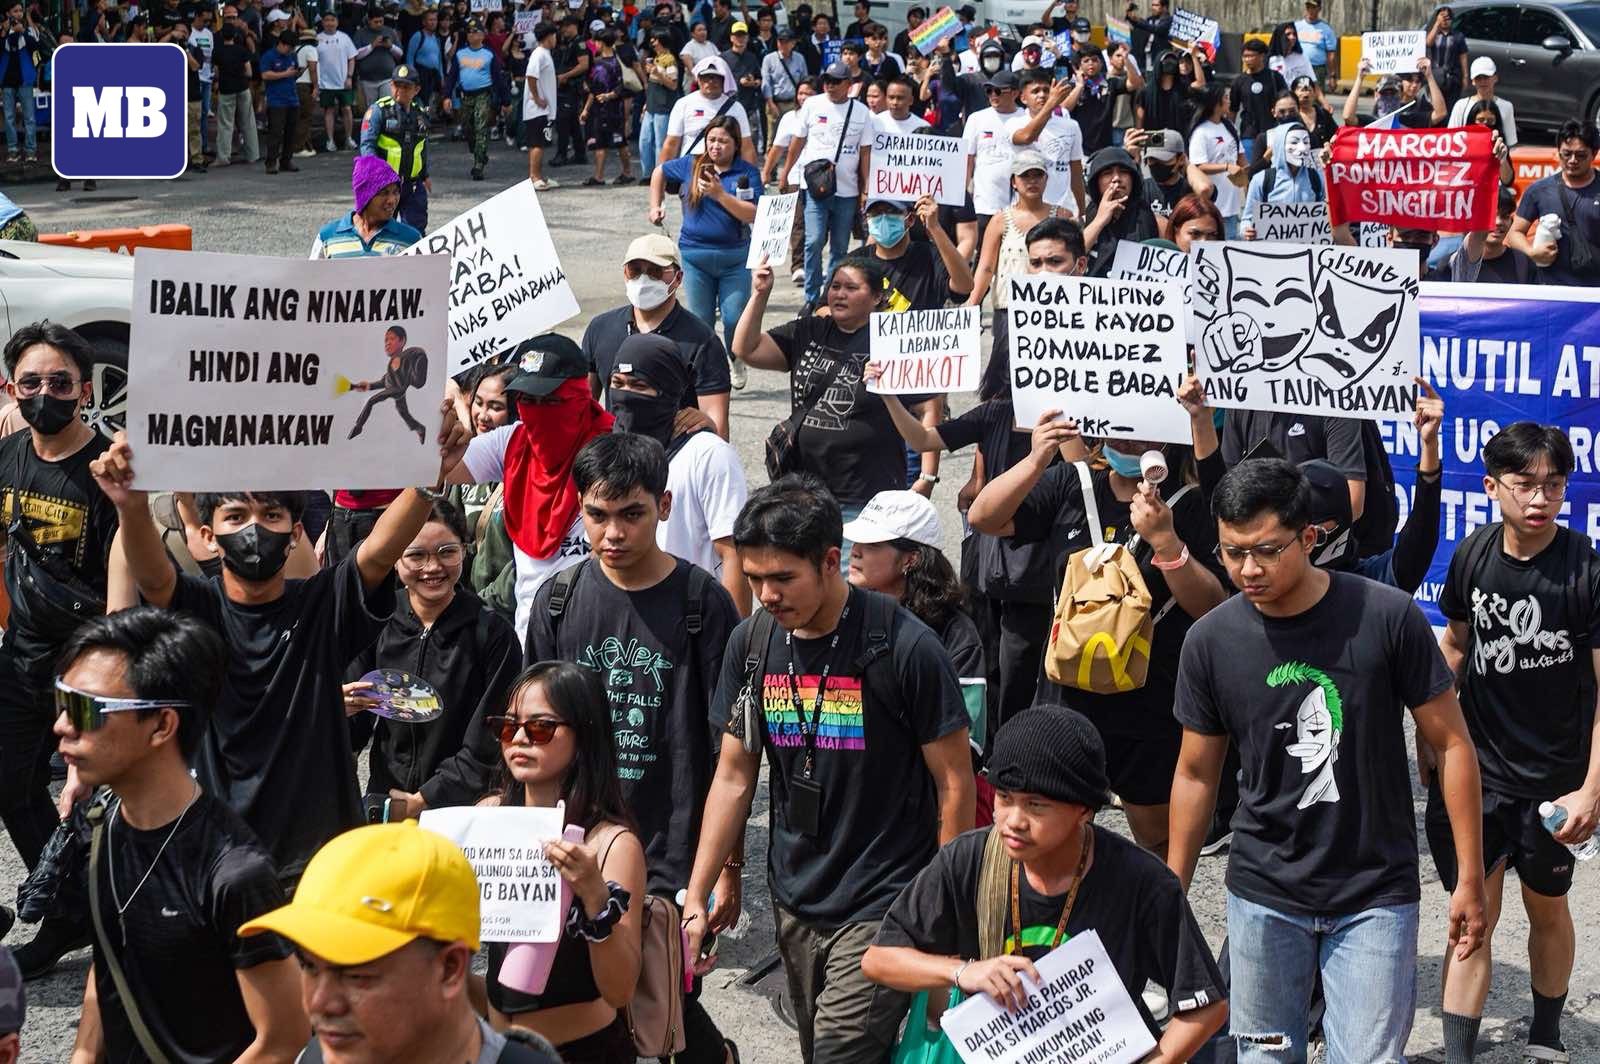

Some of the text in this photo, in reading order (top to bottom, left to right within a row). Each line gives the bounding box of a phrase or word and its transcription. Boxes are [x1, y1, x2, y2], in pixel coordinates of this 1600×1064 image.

[875, 134, 914, 151] SARAH
[915, 138, 959, 153] DISCAYA
[1356, 130, 1468, 159] MARCOS
[887, 154, 943, 167] MALAKING
[1332, 159, 1475, 187] ROMUALDEZ
[877, 169, 944, 198] BUWAYA
[1361, 188, 1475, 220] SINGILIN
[452, 246, 494, 284] AYA
[1318, 248, 1419, 300] GISING NA
[449, 254, 523, 308] TABA!
[491, 266, 566, 321] BINABAHA
[1011, 279, 1070, 305] MGA
[1079, 282, 1165, 306] PILIPINO
[1193, 248, 1222, 322] LAGOT
[150, 280, 424, 323] IBALIK ANG NINAKAW.
[878, 309, 971, 337] KATARUNGAN
[1014, 310, 1174, 332] DOBLE KAYOD
[900, 334, 960, 354] LABAN SA
[1017, 336, 1163, 363] ROMUALDEZ
[189, 350, 320, 386] HINDI ANG
[876, 354, 969, 390] KURAKOT
[1015, 366, 1099, 393] DOBLE
[1422, 335, 1541, 396] NUTIL
[1204, 377, 1418, 413] ANG TAUMBAYAN
[148, 414, 334, 447] MAGNANAKAW
[606, 690, 662, 707] THE FALLS
[479, 847, 505, 860] KAMI
[509, 848, 522, 860] SA
[515, 865, 538, 878] SILA
[542, 865, 556, 878] SA
[498, 883, 556, 902] BAYAN
[495, 916, 511, 924] FOR
[964, 1011, 1013, 1052] DALHIN
[1040, 958, 1096, 1002] PAHIRAP
[984, 982, 1098, 1060] NA SI MARCOS JR.
[1023, 1007, 1105, 1064] HUKUMAN NG
